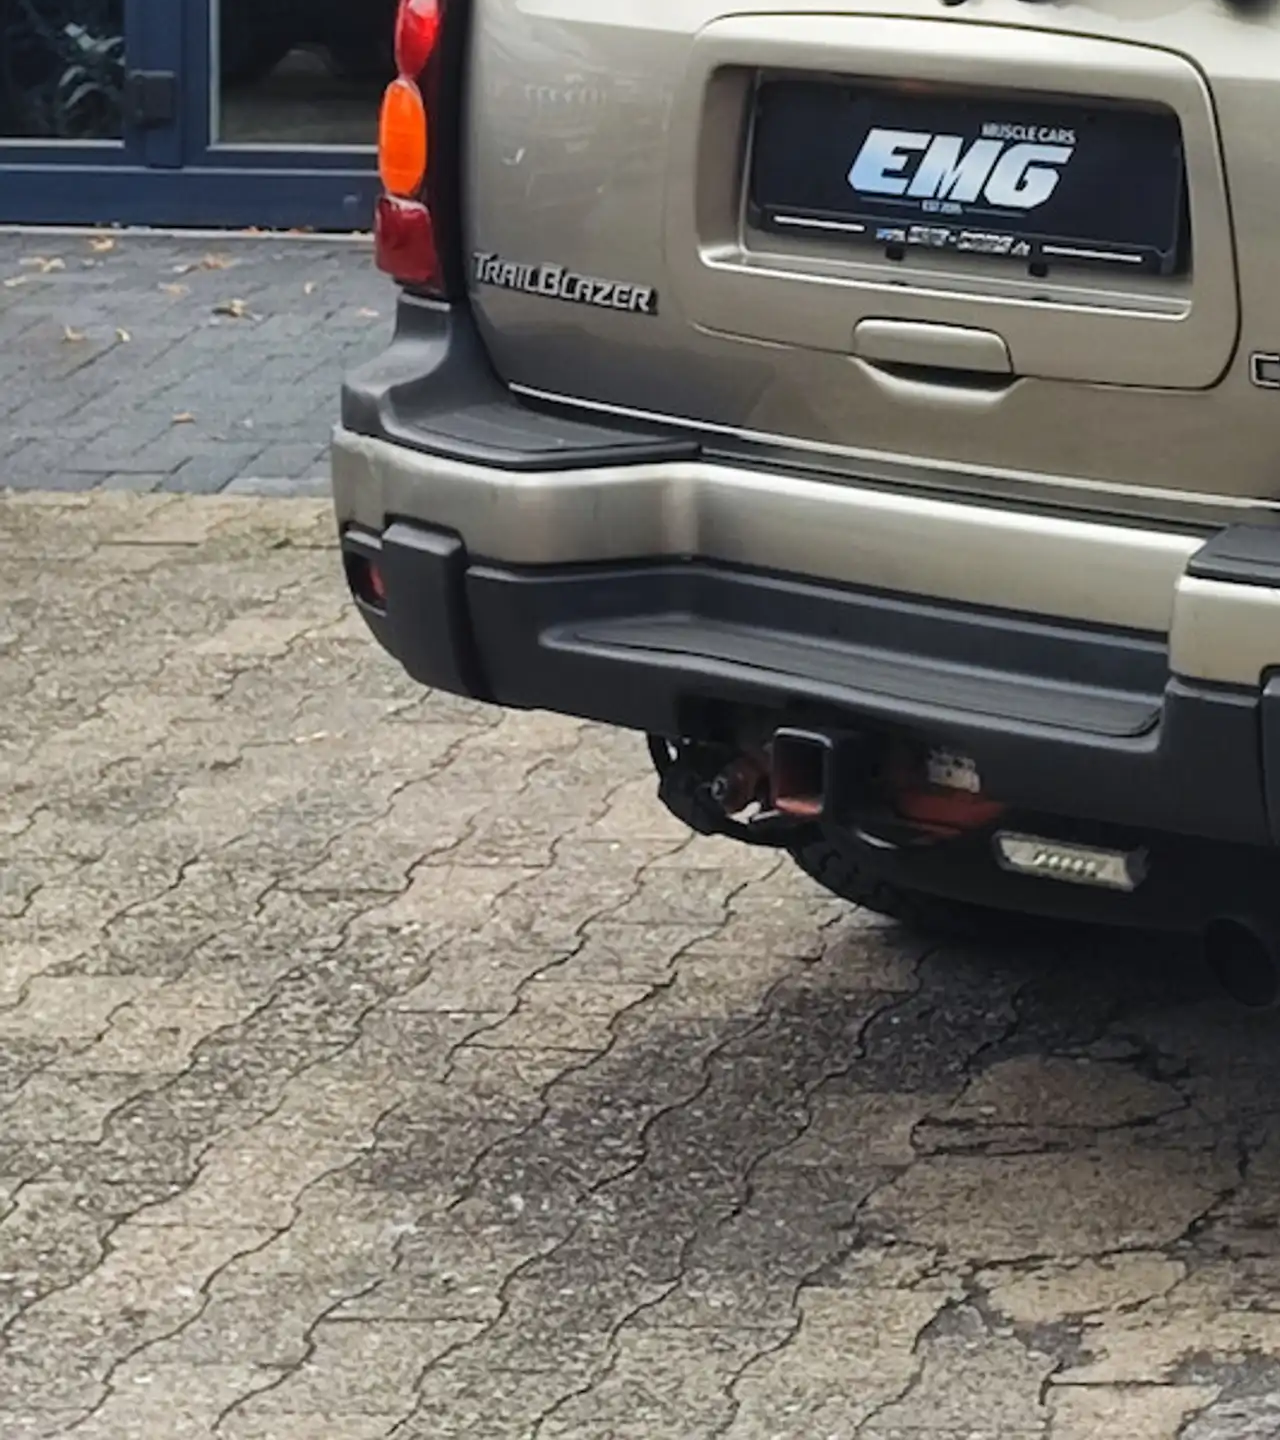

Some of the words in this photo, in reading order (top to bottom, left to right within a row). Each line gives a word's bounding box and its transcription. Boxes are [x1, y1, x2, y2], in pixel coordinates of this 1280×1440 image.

[981, 123, 1037, 141] MUSCLE
[1037, 127, 1076, 144] CARS
[847, 128, 1074, 208] EMG
[473, 251, 656, 314] TRAILBLAZER
